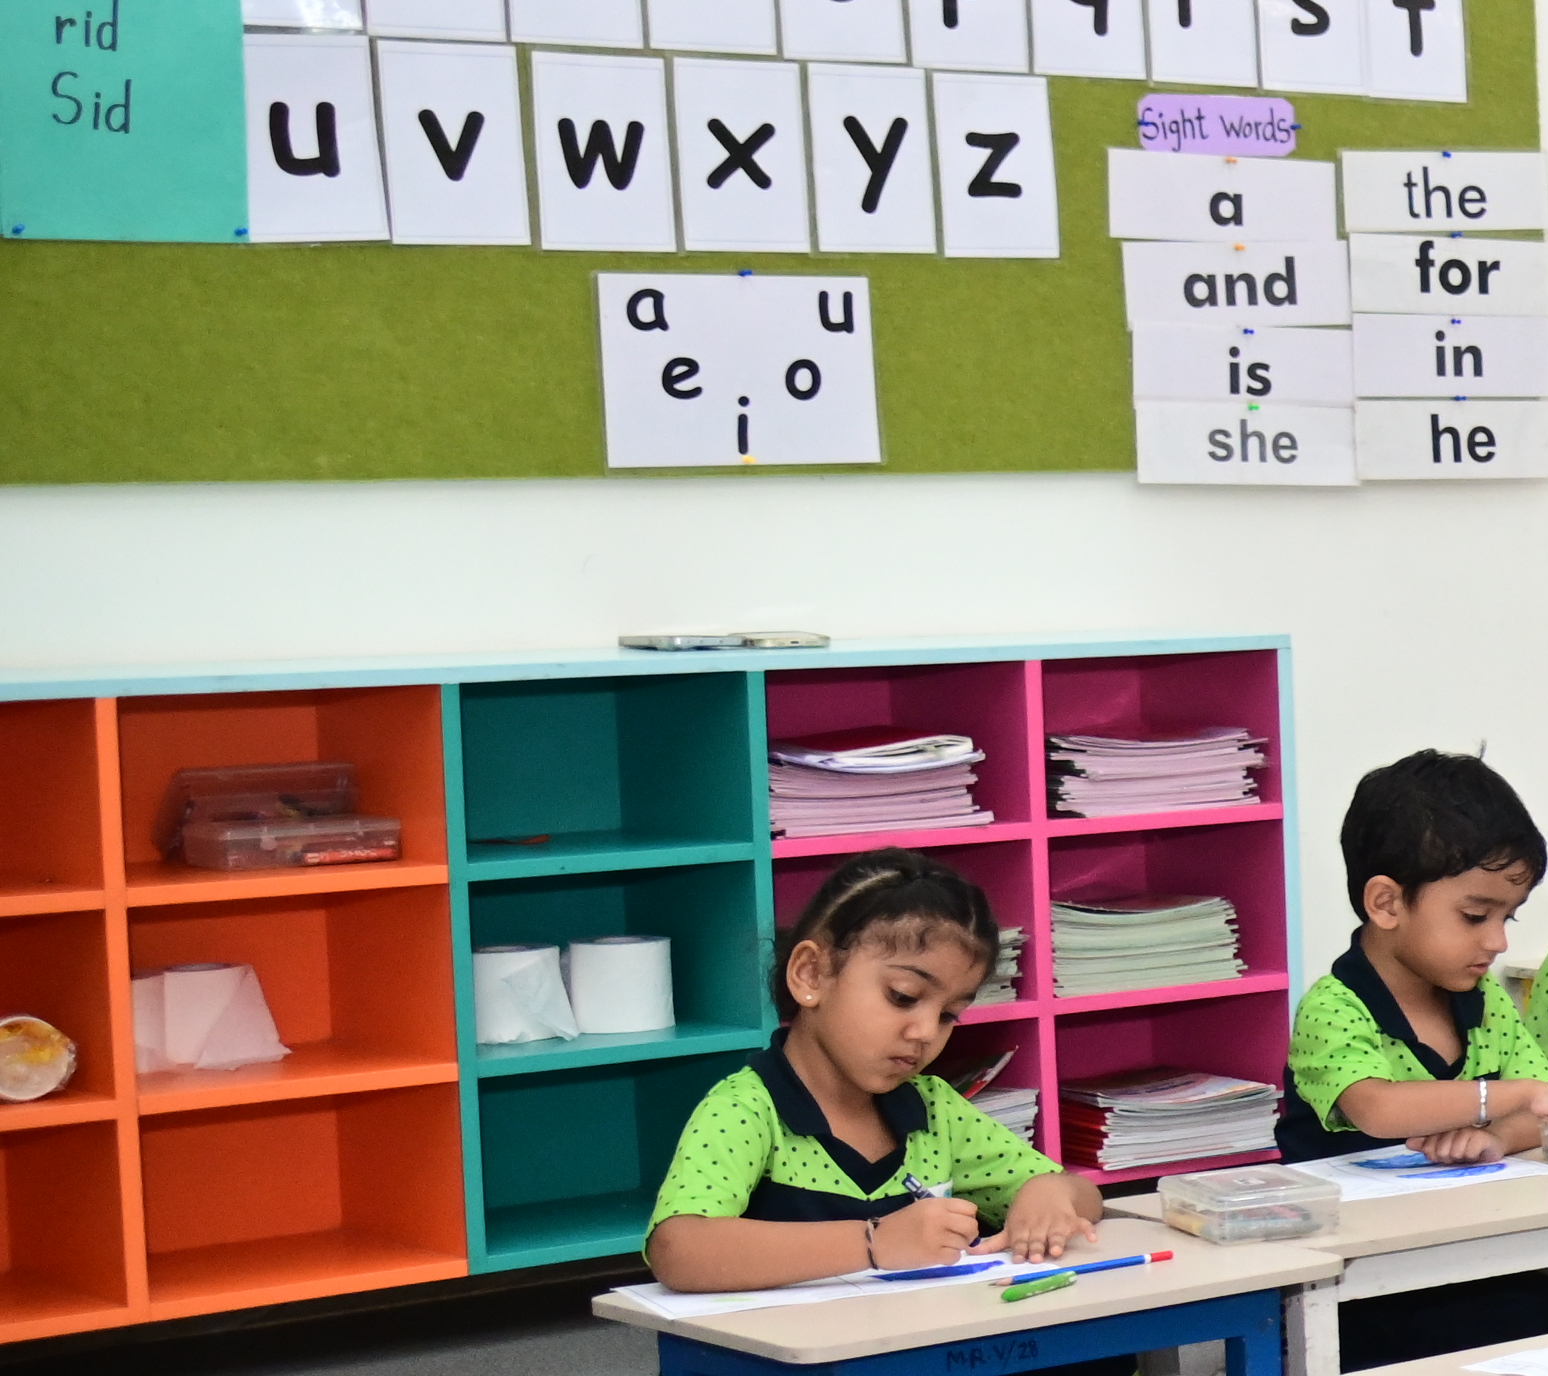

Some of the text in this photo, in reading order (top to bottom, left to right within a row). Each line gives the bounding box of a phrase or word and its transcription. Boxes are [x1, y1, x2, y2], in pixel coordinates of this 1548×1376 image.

[1141, 106, 1209, 152] Sight
[268, 101, 1023, 214] u v w x y z
[1209, 191, 1243, 227] a
[1403, 166, 1487, 220] the
[1183, 256, 1298, 308] and
[1414, 238, 1501, 296] for
[626, 288, 855, 334] a u
[661, 356, 822, 401] e o
[1228, 348, 1272, 397] is
[1434, 331, 1483, 378] in
[737, 395, 750, 456] i
[1208, 419, 1298, 464] she
[1430, 413, 1497, 464] he
